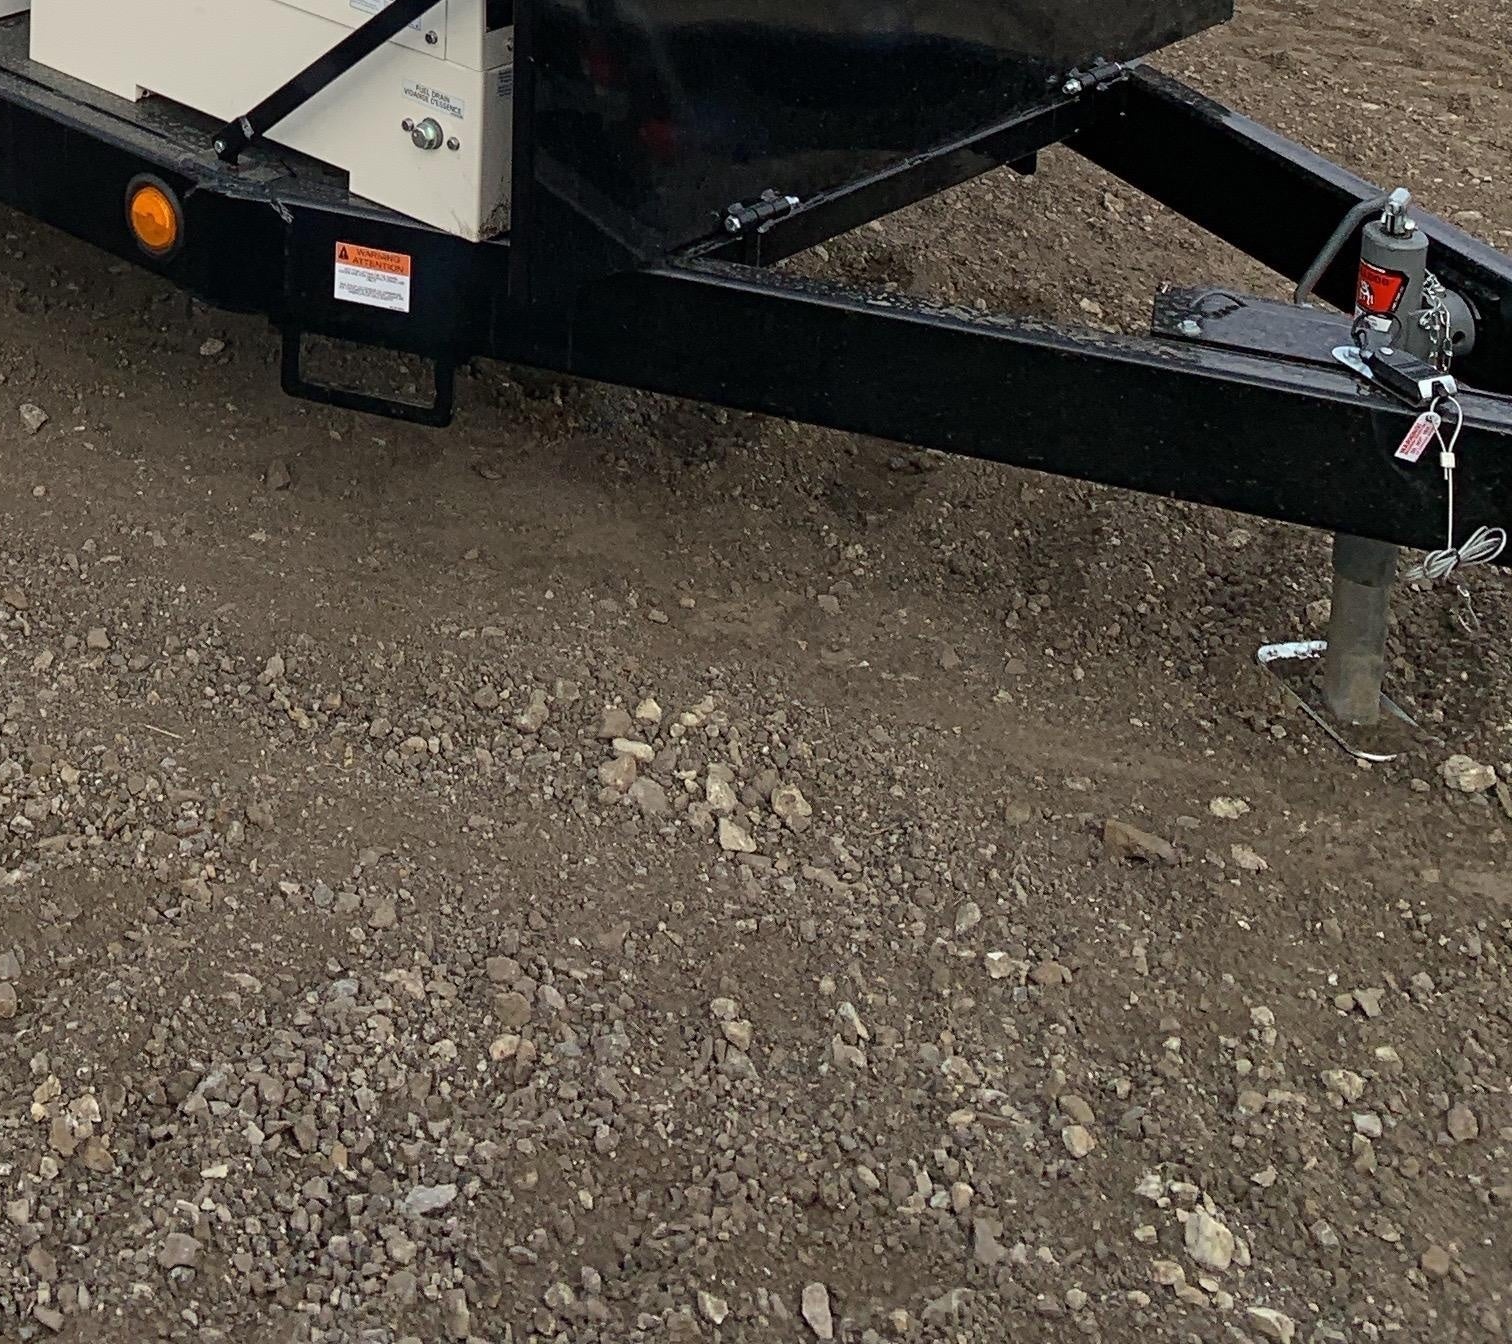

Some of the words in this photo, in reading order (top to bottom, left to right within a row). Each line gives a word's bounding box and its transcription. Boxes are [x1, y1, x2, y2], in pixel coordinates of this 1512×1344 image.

[416, 84, 429, 96] FUEL
[432, 90, 450, 103] DRAIN
[357, 249, 400, 263] WARNING
[352, 257, 404, 272] ATTENTION
